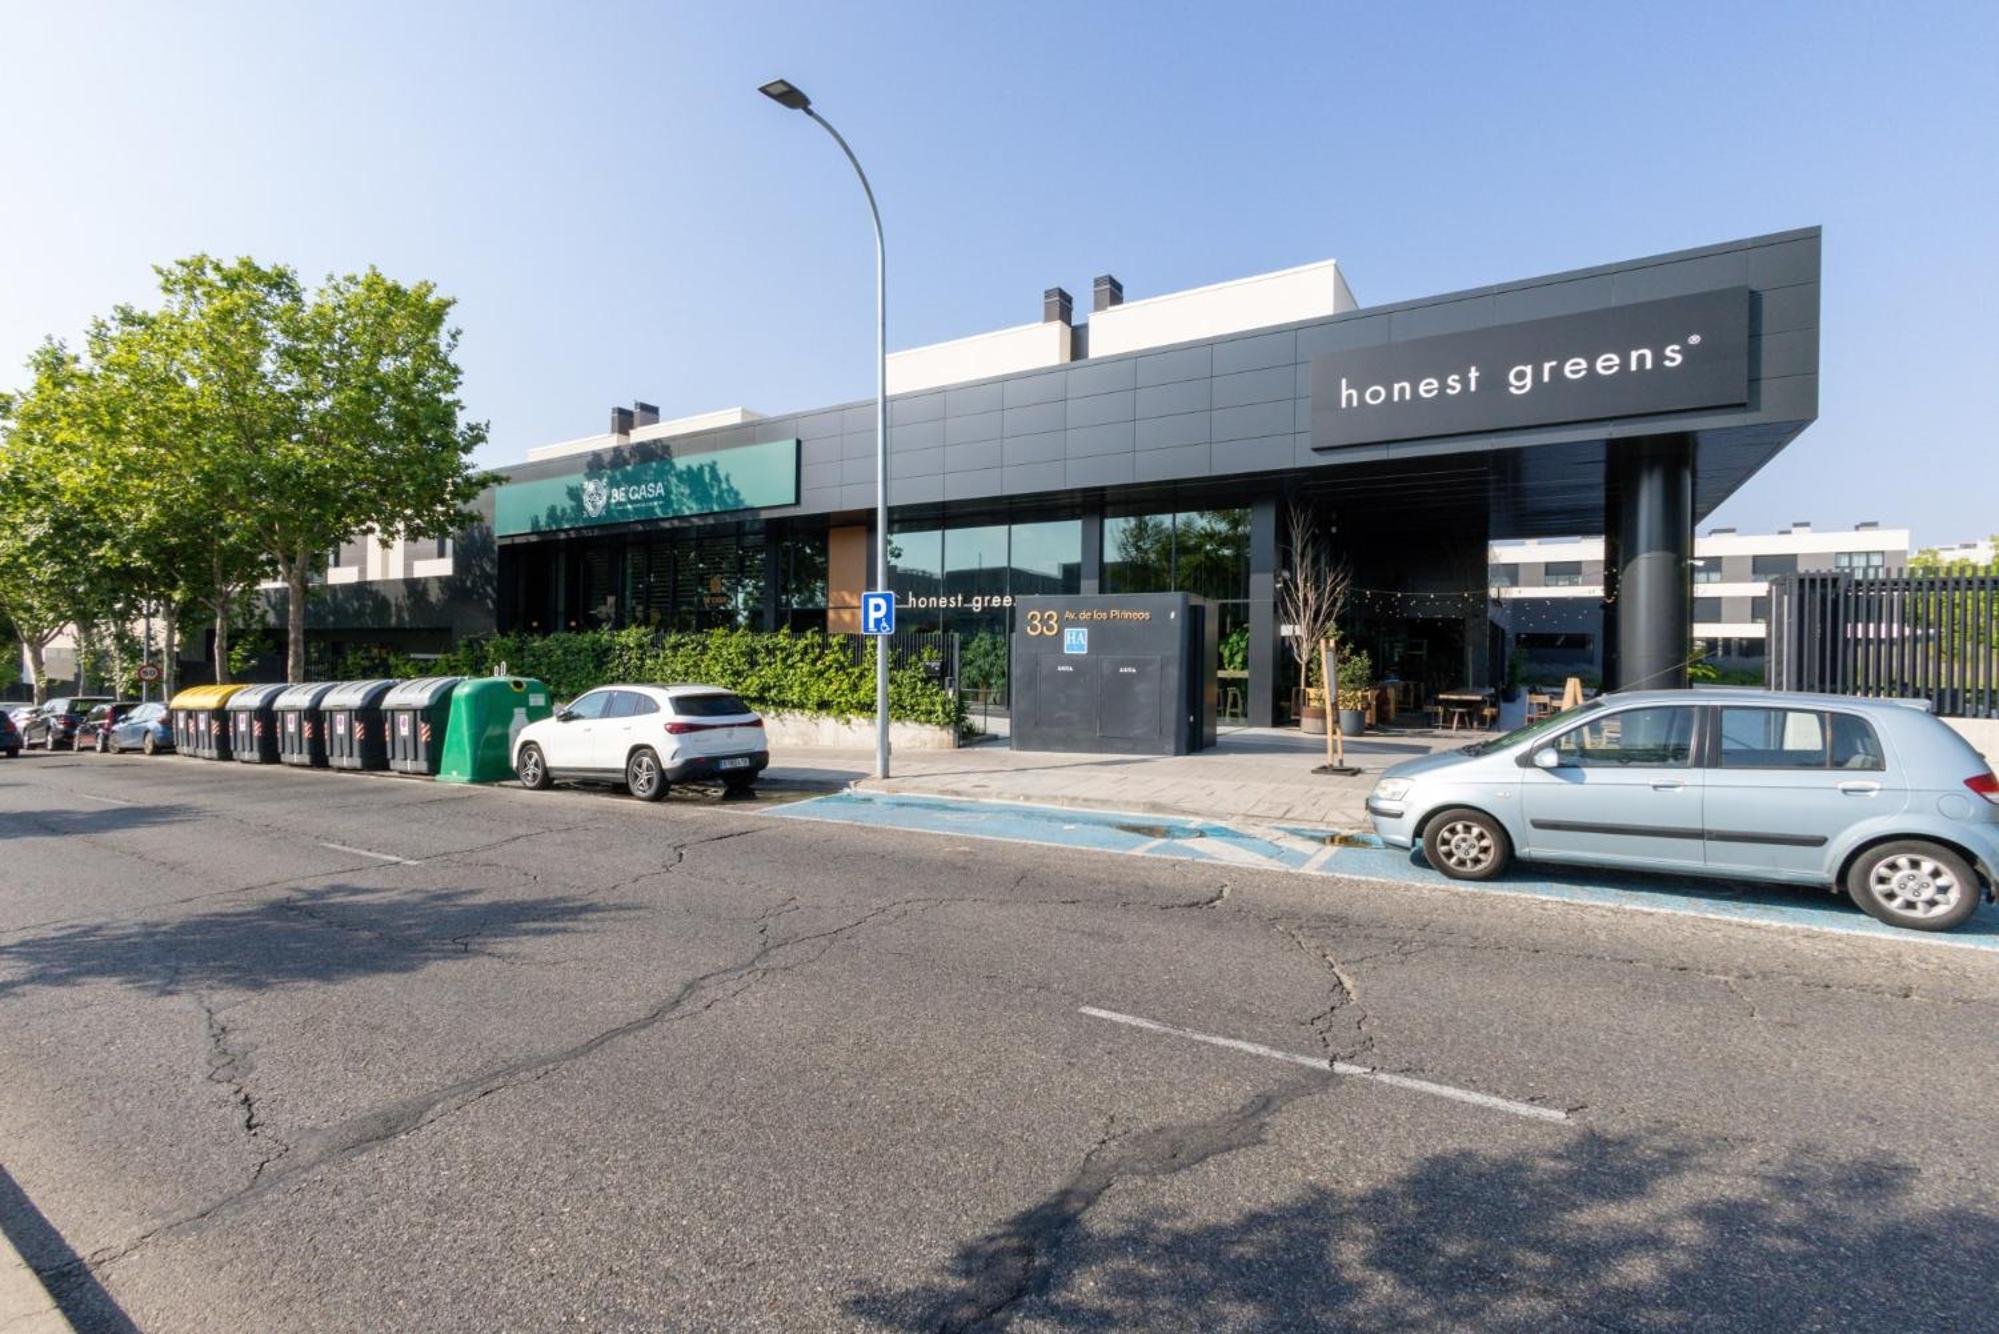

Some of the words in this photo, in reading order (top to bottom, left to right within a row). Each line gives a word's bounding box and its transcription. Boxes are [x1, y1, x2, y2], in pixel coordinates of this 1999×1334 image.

[1340, 365, 1480, 409] honest
[629, 482, 664, 500] CASA
[908, 591, 963, 608] honest
[972, 595, 1016, 612] gree
[868, 597, 887, 630] P
[1026, 610, 1058, 636] 33
[1065, 611, 1078, 620] Av.
[1079, 610, 1091, 620] de
[1093, 609, 1107, 621] los
[1110, 609, 1151, 621] Pirineos
